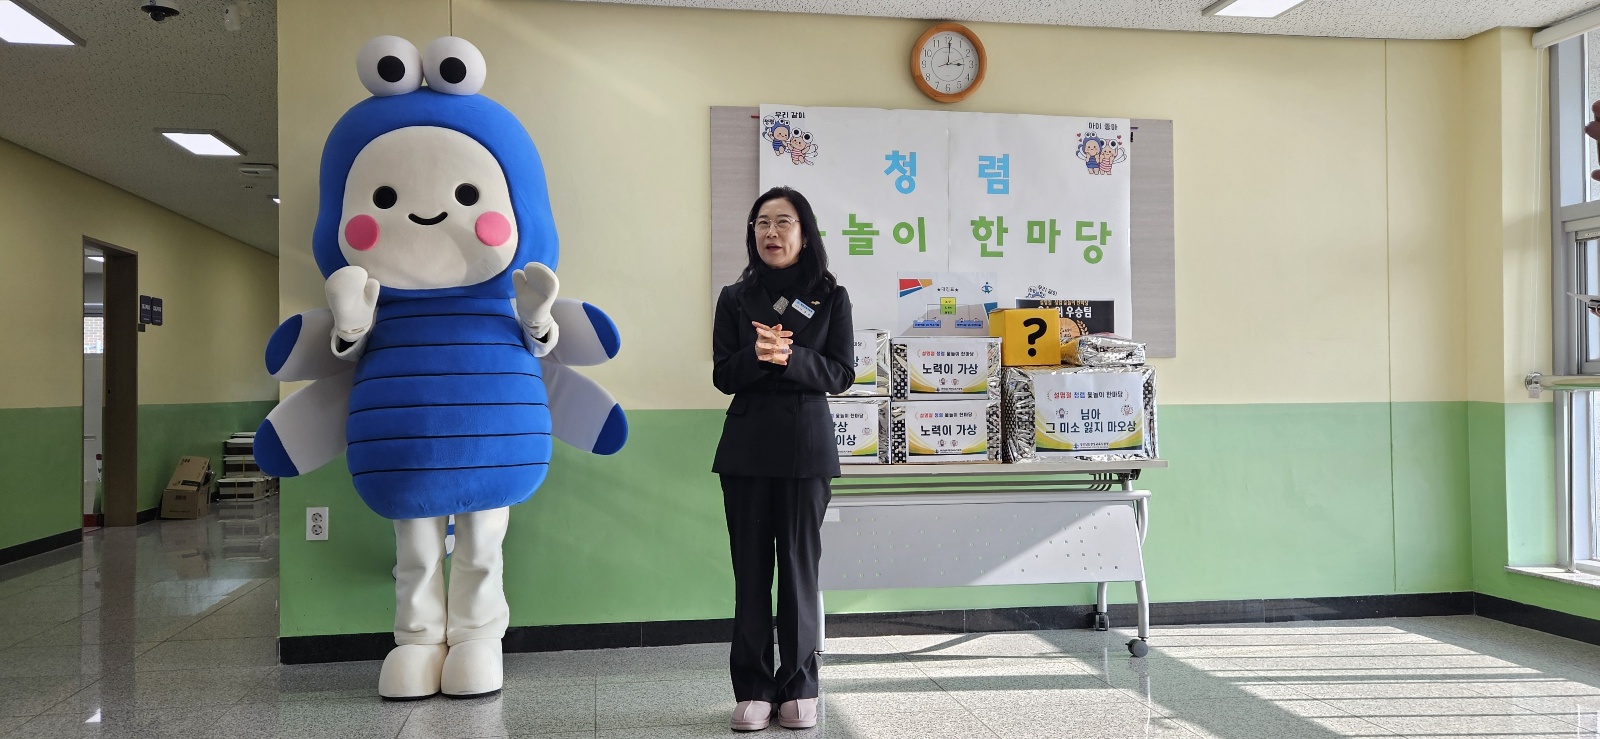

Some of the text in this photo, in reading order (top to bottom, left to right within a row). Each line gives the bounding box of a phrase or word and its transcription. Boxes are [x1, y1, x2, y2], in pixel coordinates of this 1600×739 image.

[934, 40, 940, 48] 11
[924, 49, 932, 58] 10
[966, 49, 970, 57] 2
[922, 60, 926, 68] 9
[969, 60, 974, 68] 3
[926, 73, 930, 81] 8
[965, 73, 970, 81] 4
[946, 84, 950, 92] 6
[957, 81, 961, 89] 5
[818, 214, 1112, 264] 놀이 한마당
[1066, 306, 1092, 318] 우승팀
[922, 364, 978, 374] 노력이 가상
[1081, 409, 1101, 420] 님아
[921, 424, 977, 436] 노력이 가상
[1046, 421, 1136, 433] 그 미소 잃지 마오상
